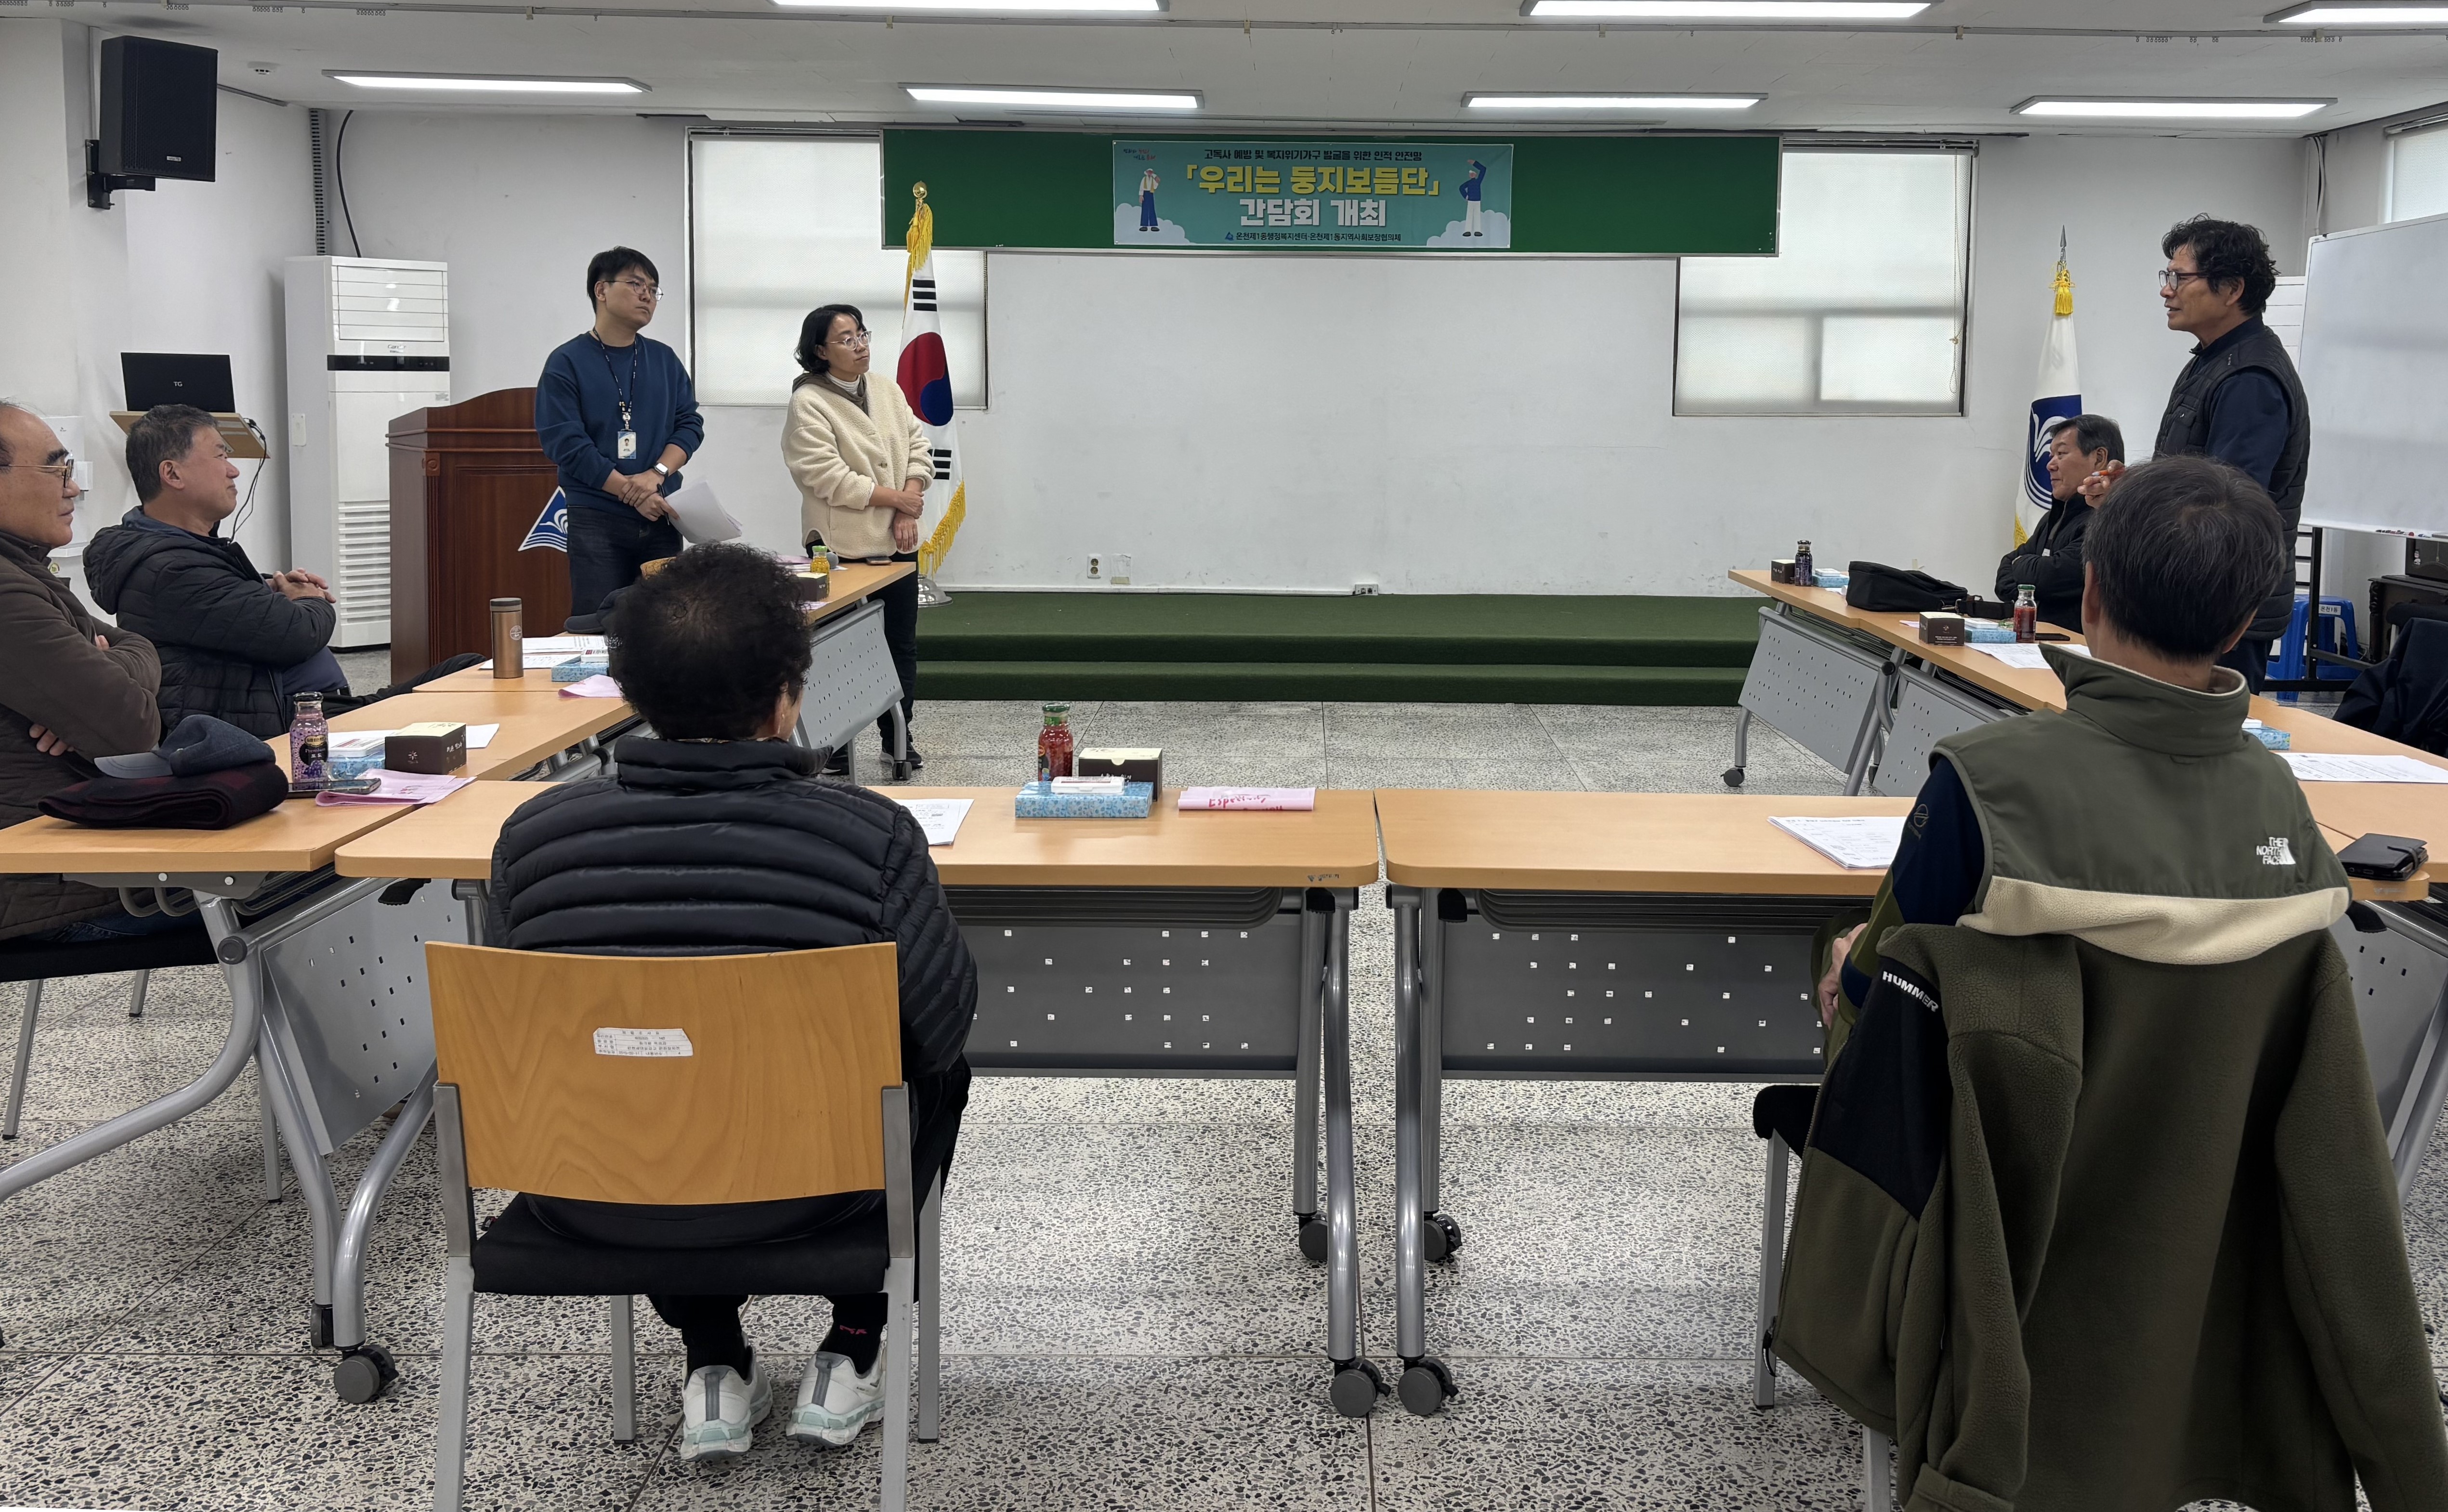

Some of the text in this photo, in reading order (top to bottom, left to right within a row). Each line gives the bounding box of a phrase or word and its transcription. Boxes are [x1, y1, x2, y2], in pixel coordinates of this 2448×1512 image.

[1204, 149, 1422, 161] 고독사 예방 및 복지위기가구 발굴을 위한 인적 안전망
[1239, 198, 1386, 227] 간담회 개최
[2268, 836, 2283, 847] THE
[2256, 845, 2281, 856] NORTH
[1882, 971, 1938, 1012] HUMMER
